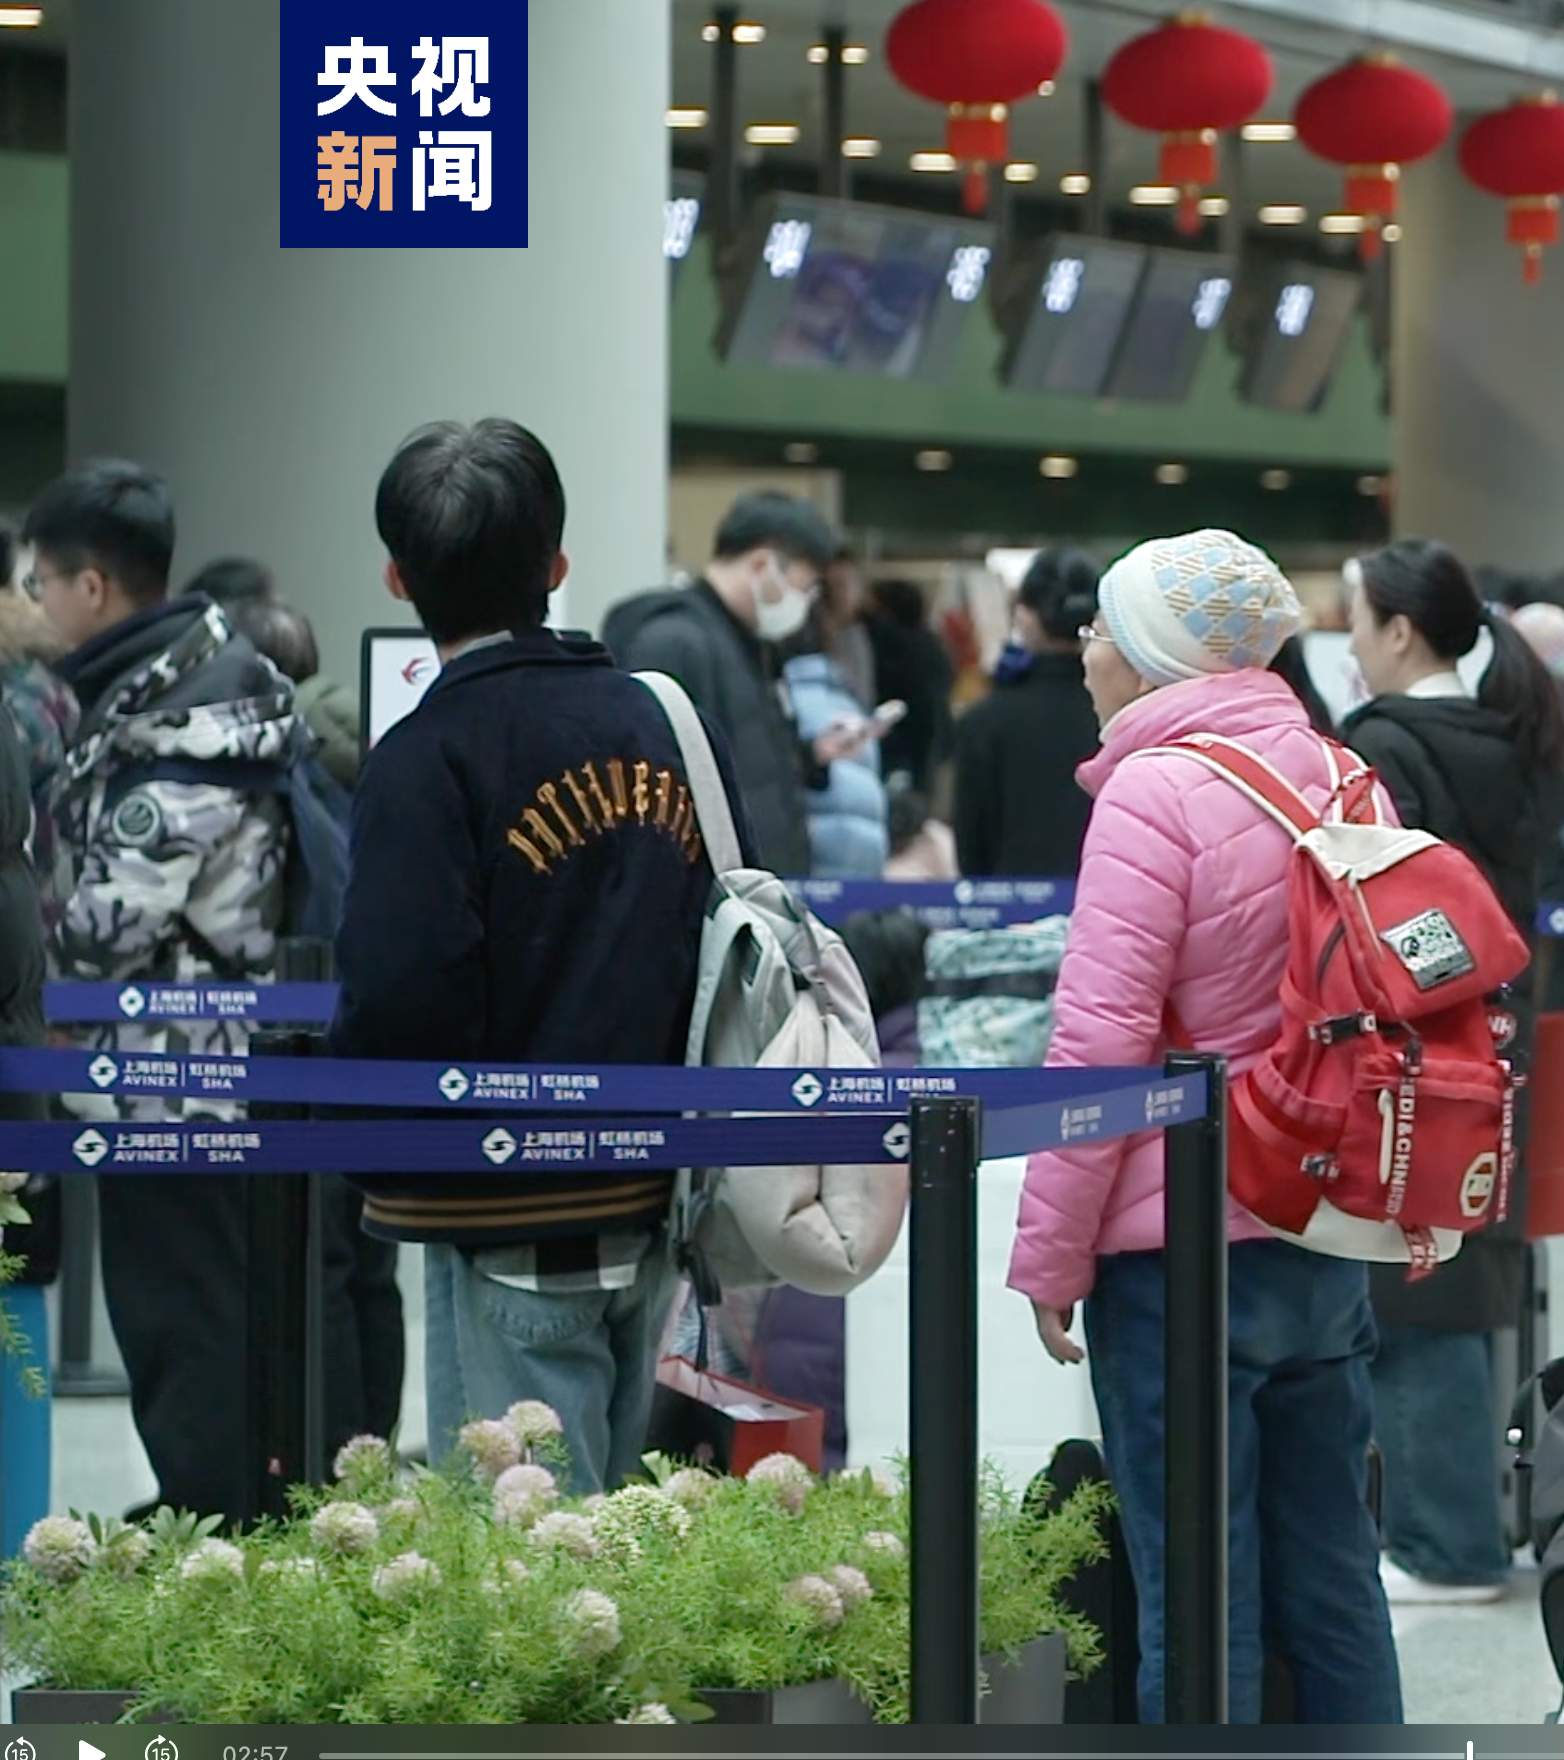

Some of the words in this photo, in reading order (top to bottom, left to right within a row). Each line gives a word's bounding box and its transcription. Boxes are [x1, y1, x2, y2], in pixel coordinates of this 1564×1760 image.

[122, 1075, 177, 1087] AVINEX
[202, 1078, 233, 1089] SHA
[473, 1087, 529, 1099] AVINEX
[554, 1089, 586, 1100] SHA
[827, 1091, 884, 1103] AVINEX
[113, 1150, 178, 1162] AVINEX
[208, 1150, 244, 1163] SHA
[521, 1148, 585, 1160] AVINEX
[613, 1148, 649, 1160] SHA
